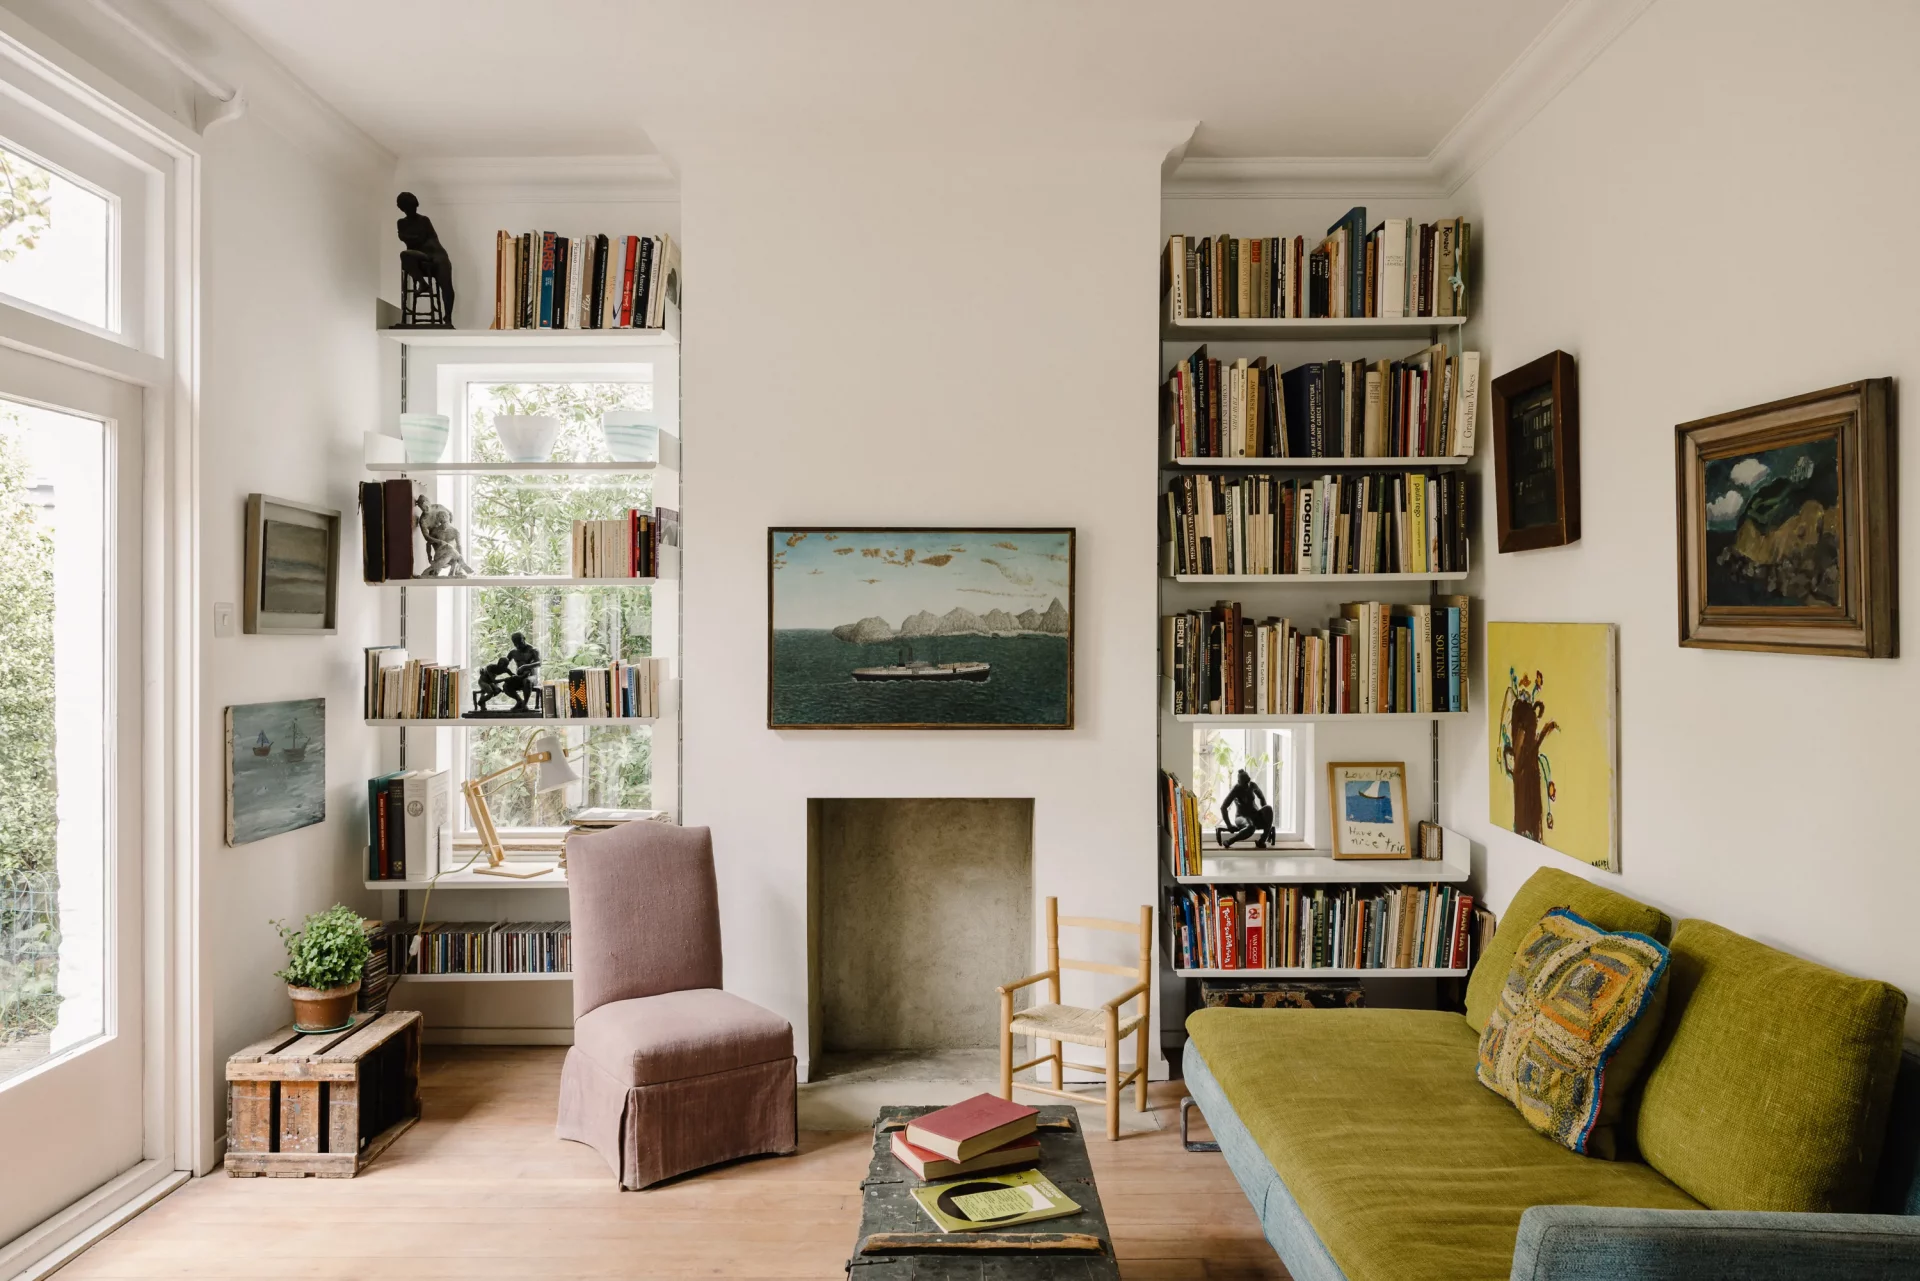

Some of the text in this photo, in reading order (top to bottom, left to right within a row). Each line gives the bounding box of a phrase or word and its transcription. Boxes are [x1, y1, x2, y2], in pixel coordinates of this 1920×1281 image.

[543, 233, 555, 271] PARIS
[638, 273, 646, 297] America
[1243, 278, 1249, 286] OF
[1463, 373, 1476, 439] Grandma Moses
[1413, 483, 1422, 502] paula
[1413, 502, 1422, 518] rego
[1302, 493, 1312, 557] noguchi
[1381, 614, 1389, 648] BONNARD
[1460, 597, 1468, 684] VINCENT VAN GOGH
[1371, 658, 1376, 666] DE
[1435, 634, 1445, 679] SOUTINE
[1451, 633, 1459, 677] SOUTINE
[1175, 691, 1183, 713] PARIS
[1344, 770, 1370, 779] Love
[1349, 826, 1372, 837] Have
[1351, 838, 1406, 854] nice trip
[1458, 907, 1469, 953] MAN RAY
